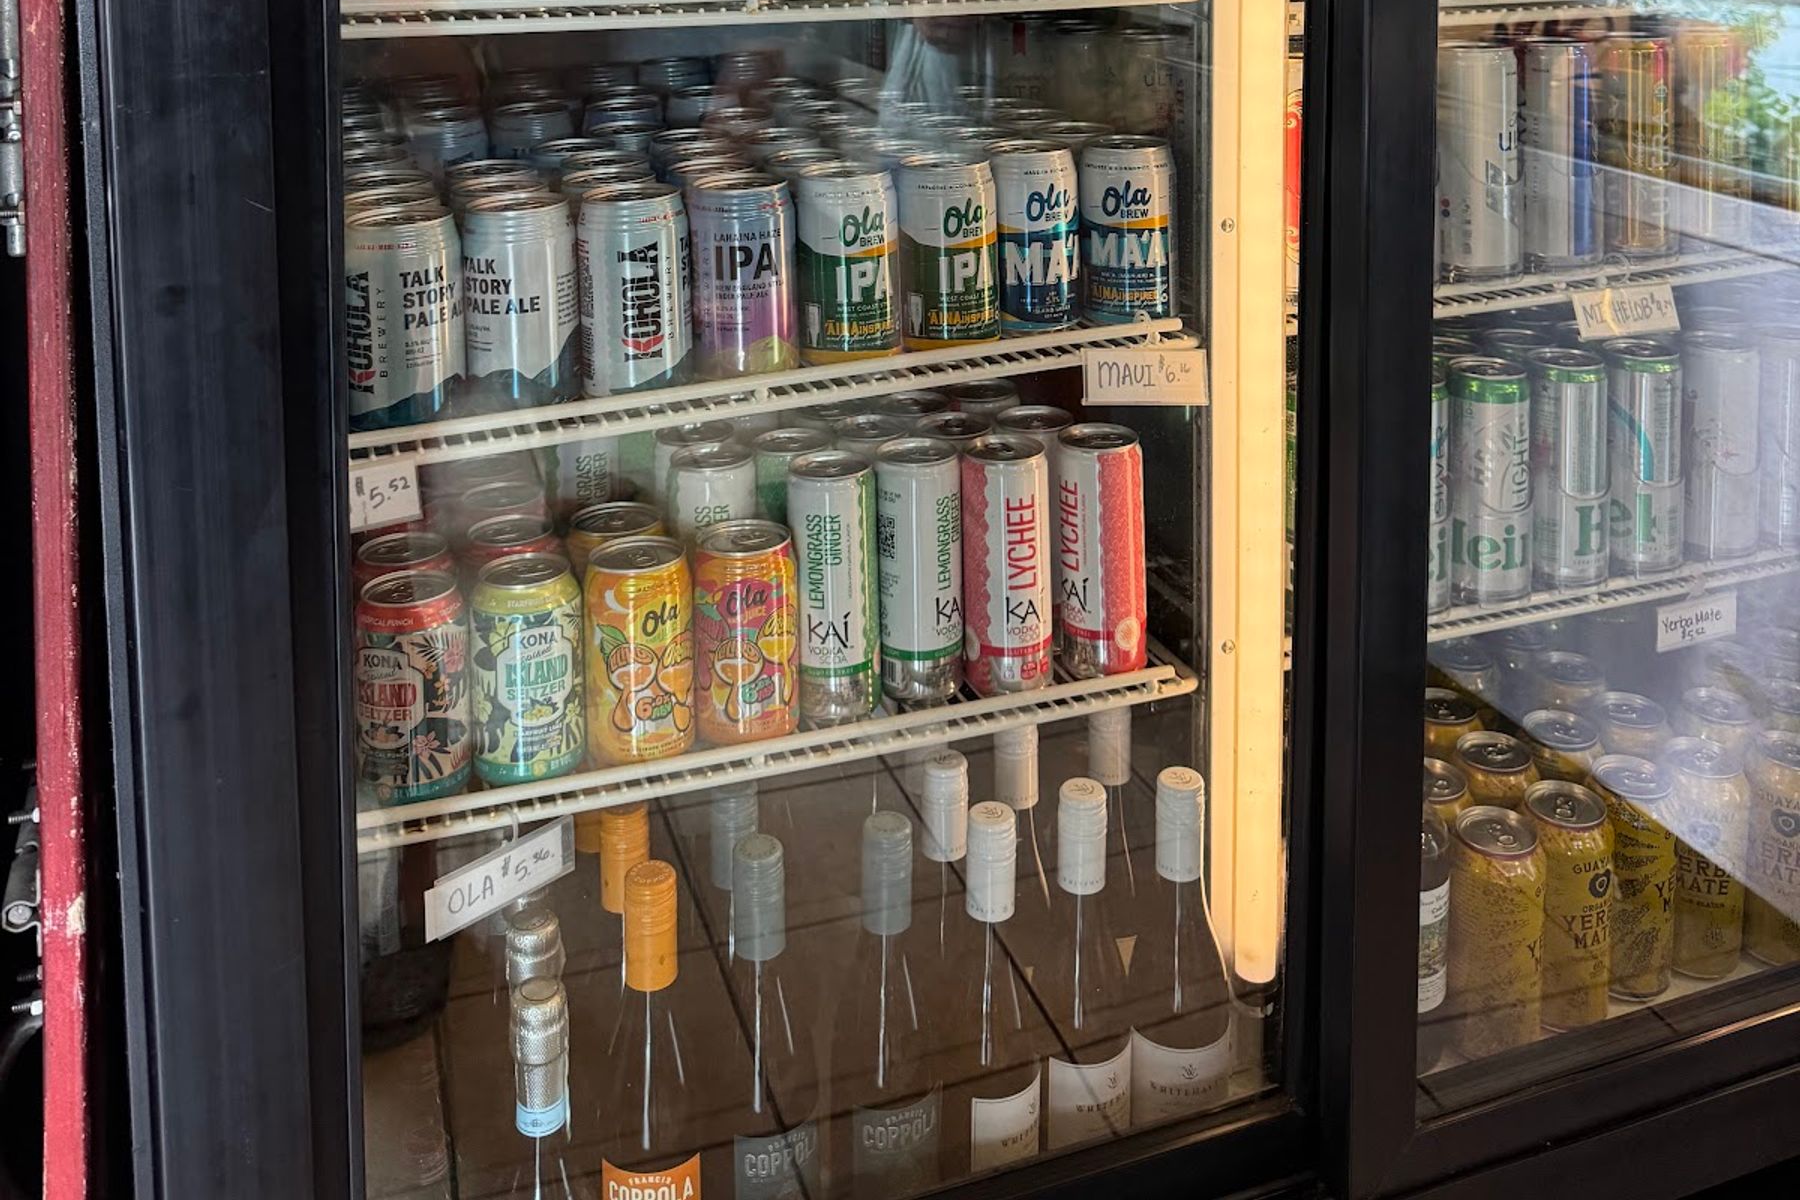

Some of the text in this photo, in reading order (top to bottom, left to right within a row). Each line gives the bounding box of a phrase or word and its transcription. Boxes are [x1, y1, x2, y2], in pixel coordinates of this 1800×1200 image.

[1025, 182, 1071, 223] Ola
[1101, 180, 1152, 218] Ola
[1120, 207, 1149, 219] BREW
[838, 205, 885, 247] Ola
[943, 197, 988, 238] Ola
[859, 234, 886, 248] BREW
[463, 256, 497, 275] TALK
[715, 242, 779, 281] IPA
[938, 247, 994, 294] IPA
[399, 265, 445, 290] TALK
[465, 276, 513, 296] STORY
[835, 255, 894, 304] IPA
[401, 281, 456, 310] STORY
[466, 295, 541, 315] PALE ALE
[403, 303, 463, 331] PALE AL
[376, 287, 389, 379] BREWERY
[1098, 360, 1156, 389] MAUI
[825, 513, 842, 567] GINGER
[1059, 479, 1080, 573] LYCHEE
[937, 494, 951, 591] LEMONGRASS
[1006, 493, 1038, 592] LYCHEE
[805, 513, 826, 610] LEMONGRASS
[726, 582, 768, 617] Ola
[642, 601, 679, 638] Ola
[363, 653, 402, 671] KONA
[808, 646, 845, 656] VODKA
[506, 678, 566, 702] SELTZER
[1572, 855, 1609, 875] GUAY
[448, 874, 495, 915] OLA
[1562, 910, 1608, 932] YER
[1573, 926, 1608, 950] MAT
[608, 1175, 694, 1200] COPPOLA
[628, 1175, 672, 1186] FRANCIS
